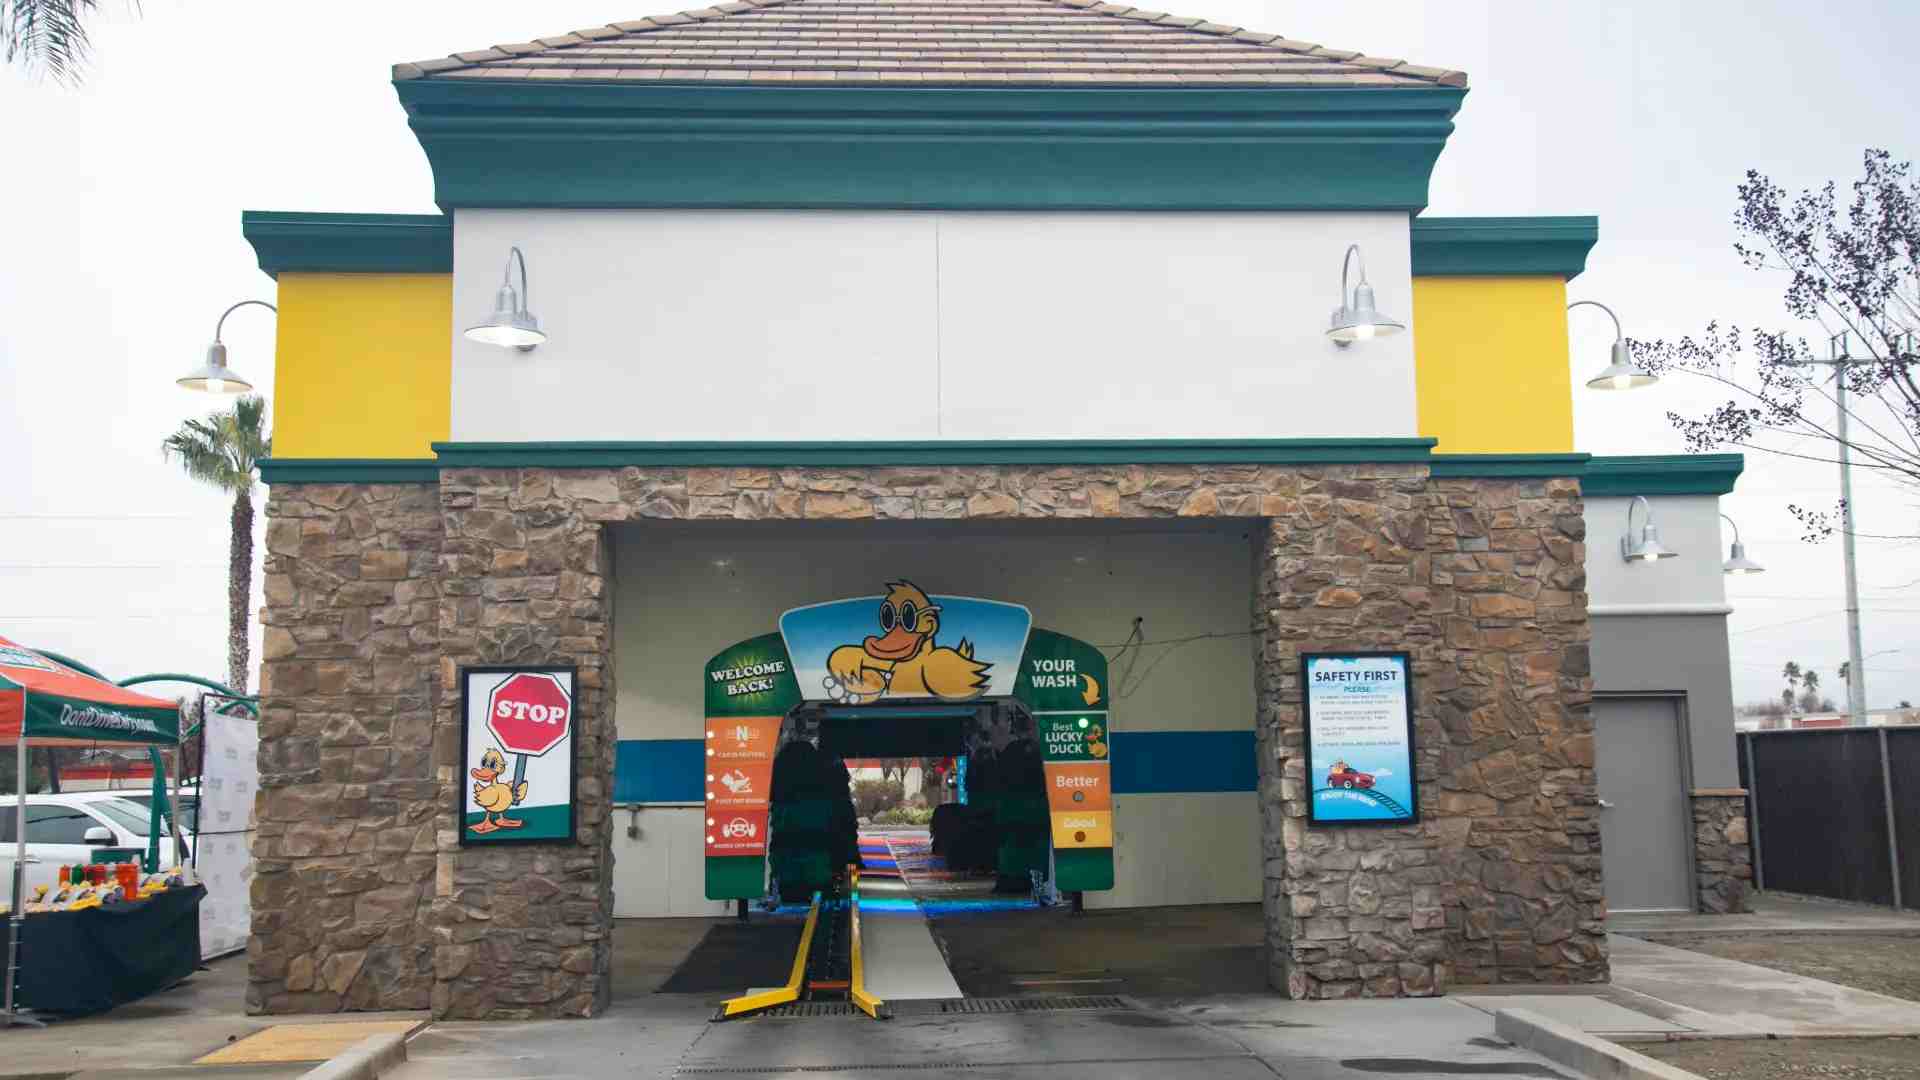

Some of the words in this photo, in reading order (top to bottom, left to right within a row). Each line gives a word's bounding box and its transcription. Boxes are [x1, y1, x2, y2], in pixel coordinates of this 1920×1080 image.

[1033, 659, 1075, 672] YOUR
[711, 662, 785, 682] WELCOME
[1315, 671, 1360, 681] SAFETY
[1364, 671, 1398, 681] FIRST
[728, 679, 773, 695] BACK!
[1032, 675, 1077, 688] WASH
[496, 700, 565, 725] STOP
[1052, 722, 1073, 732] Best
[1045, 732, 1084, 742] LUCKY
[1049, 744, 1082, 754] DUCK
[1056, 776, 1099, 788] Better
